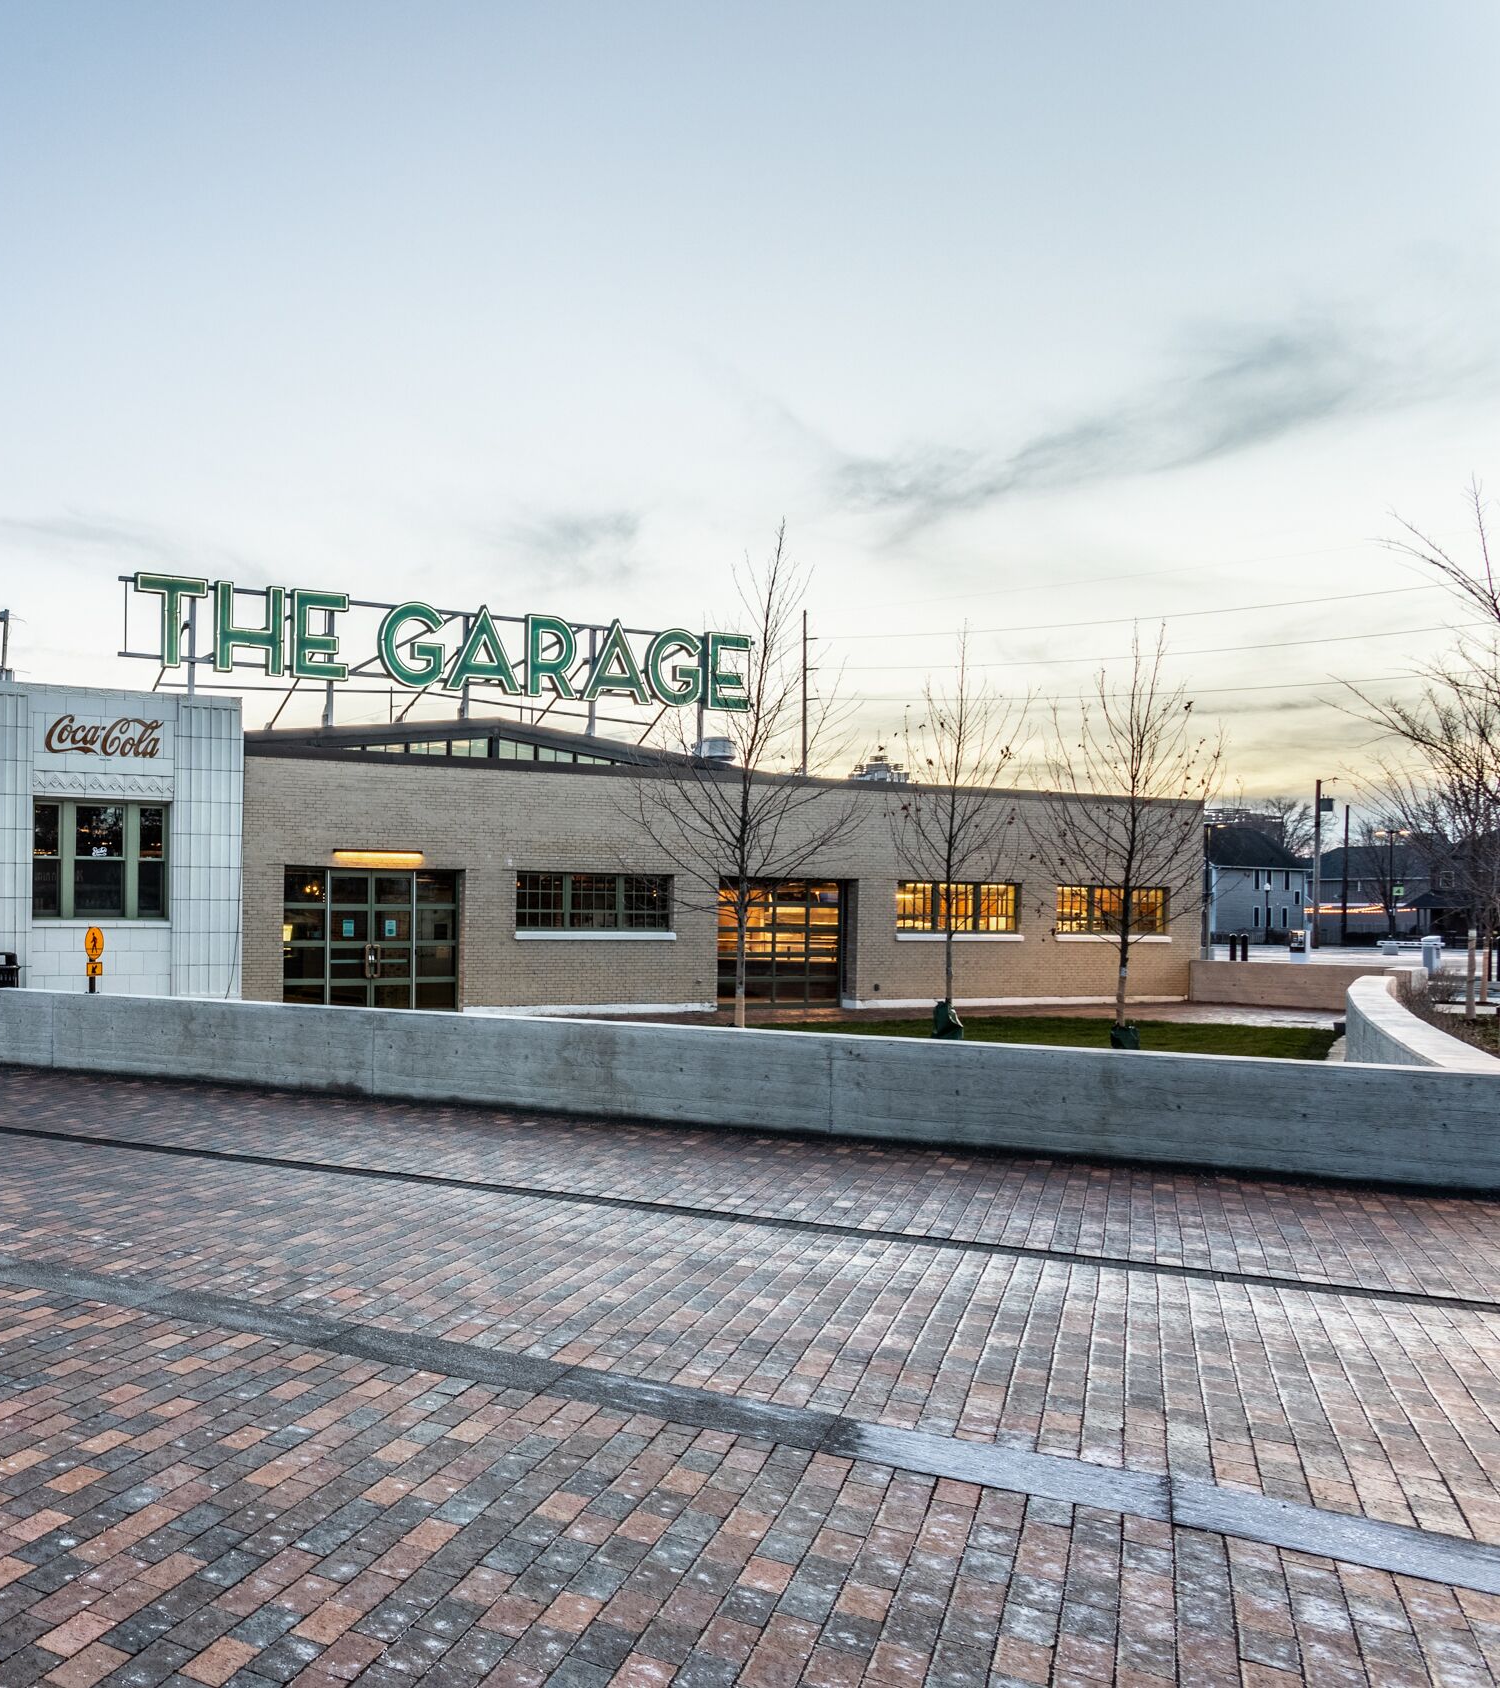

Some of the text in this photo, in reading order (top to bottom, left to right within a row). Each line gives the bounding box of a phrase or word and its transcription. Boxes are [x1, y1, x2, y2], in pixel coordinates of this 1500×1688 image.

[134, 572, 753, 713] THE GARAGE
[45, 714, 164, 758] Coca-Cola
